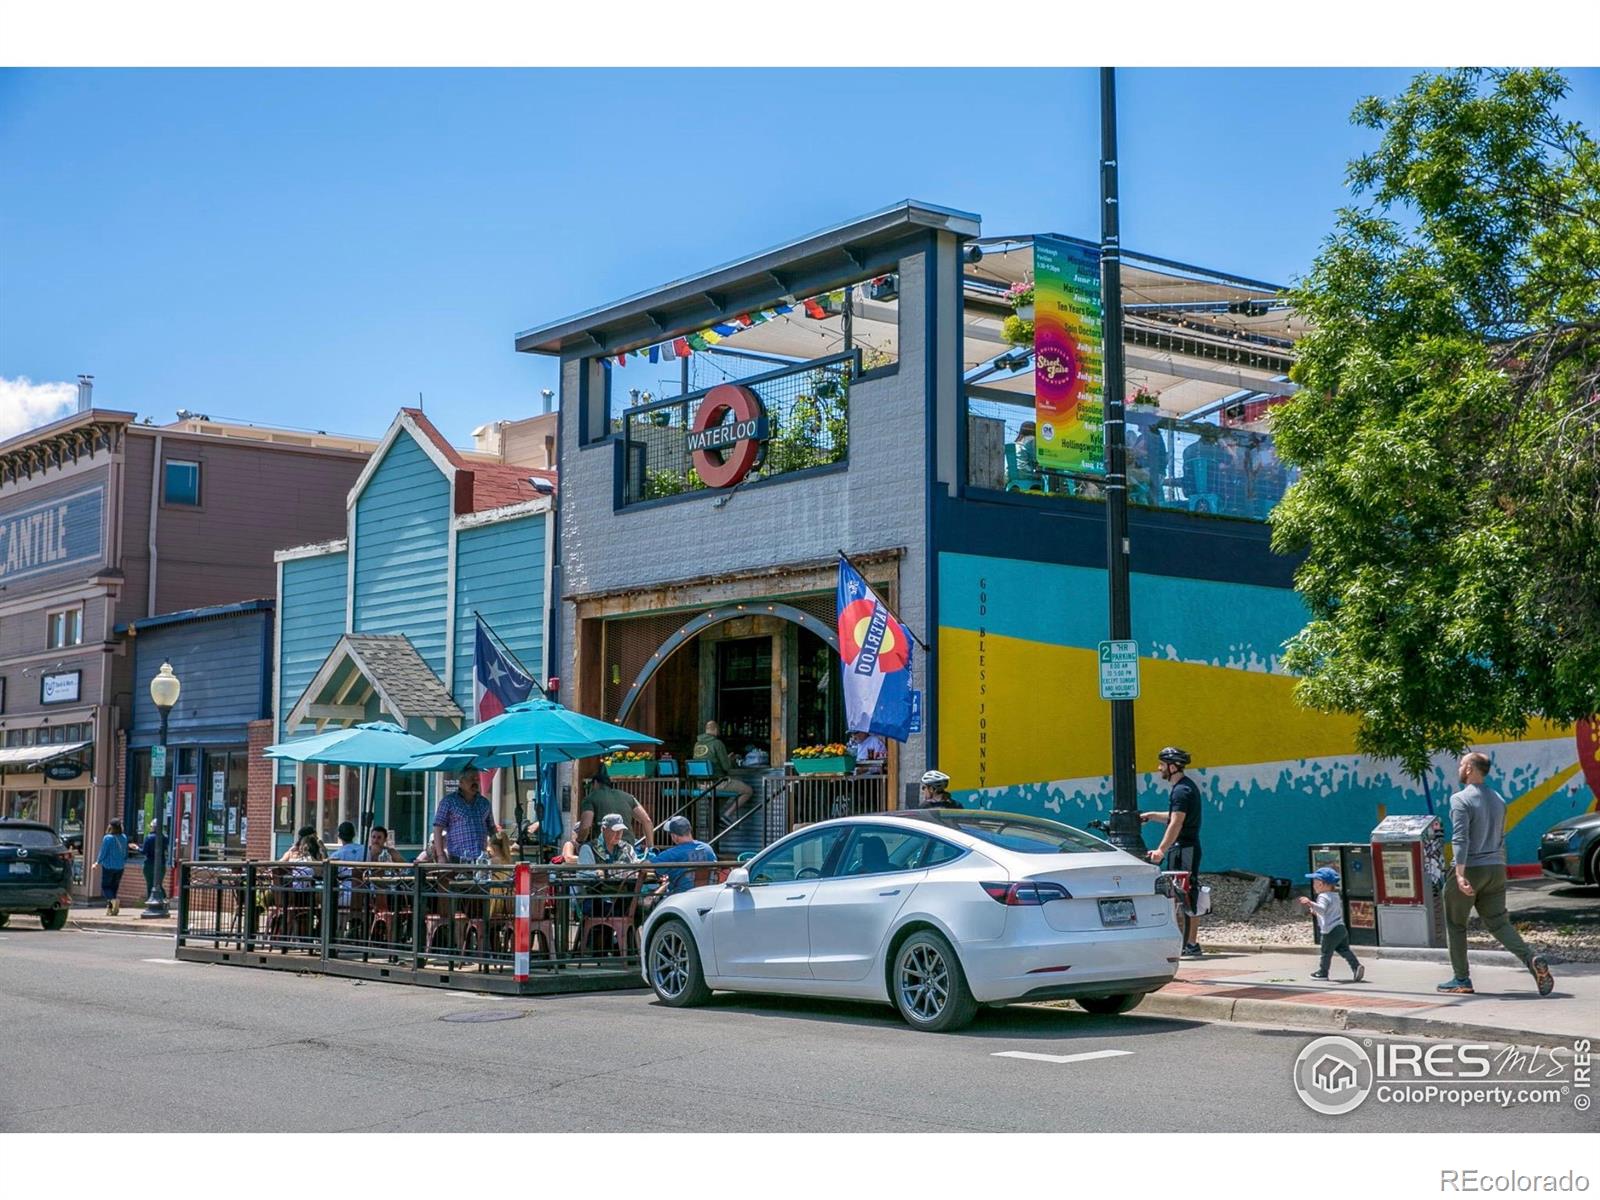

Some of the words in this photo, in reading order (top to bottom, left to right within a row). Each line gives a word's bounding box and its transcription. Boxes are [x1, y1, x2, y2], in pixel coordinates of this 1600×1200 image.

[1073, 274, 1091, 284] June
[1073, 294, 1091, 303] June
[1057, 301, 1068, 311] Ten
[1068, 303, 1085, 315] Years
[1076, 343, 1092, 353] July
[1037, 355, 1060, 368] Street
[1077, 371, 1092, 382] July
[1077, 391, 1092, 402] July
[687, 420, 756, 450] WATERLOO
[1102, 646, 1110, 660] 2
